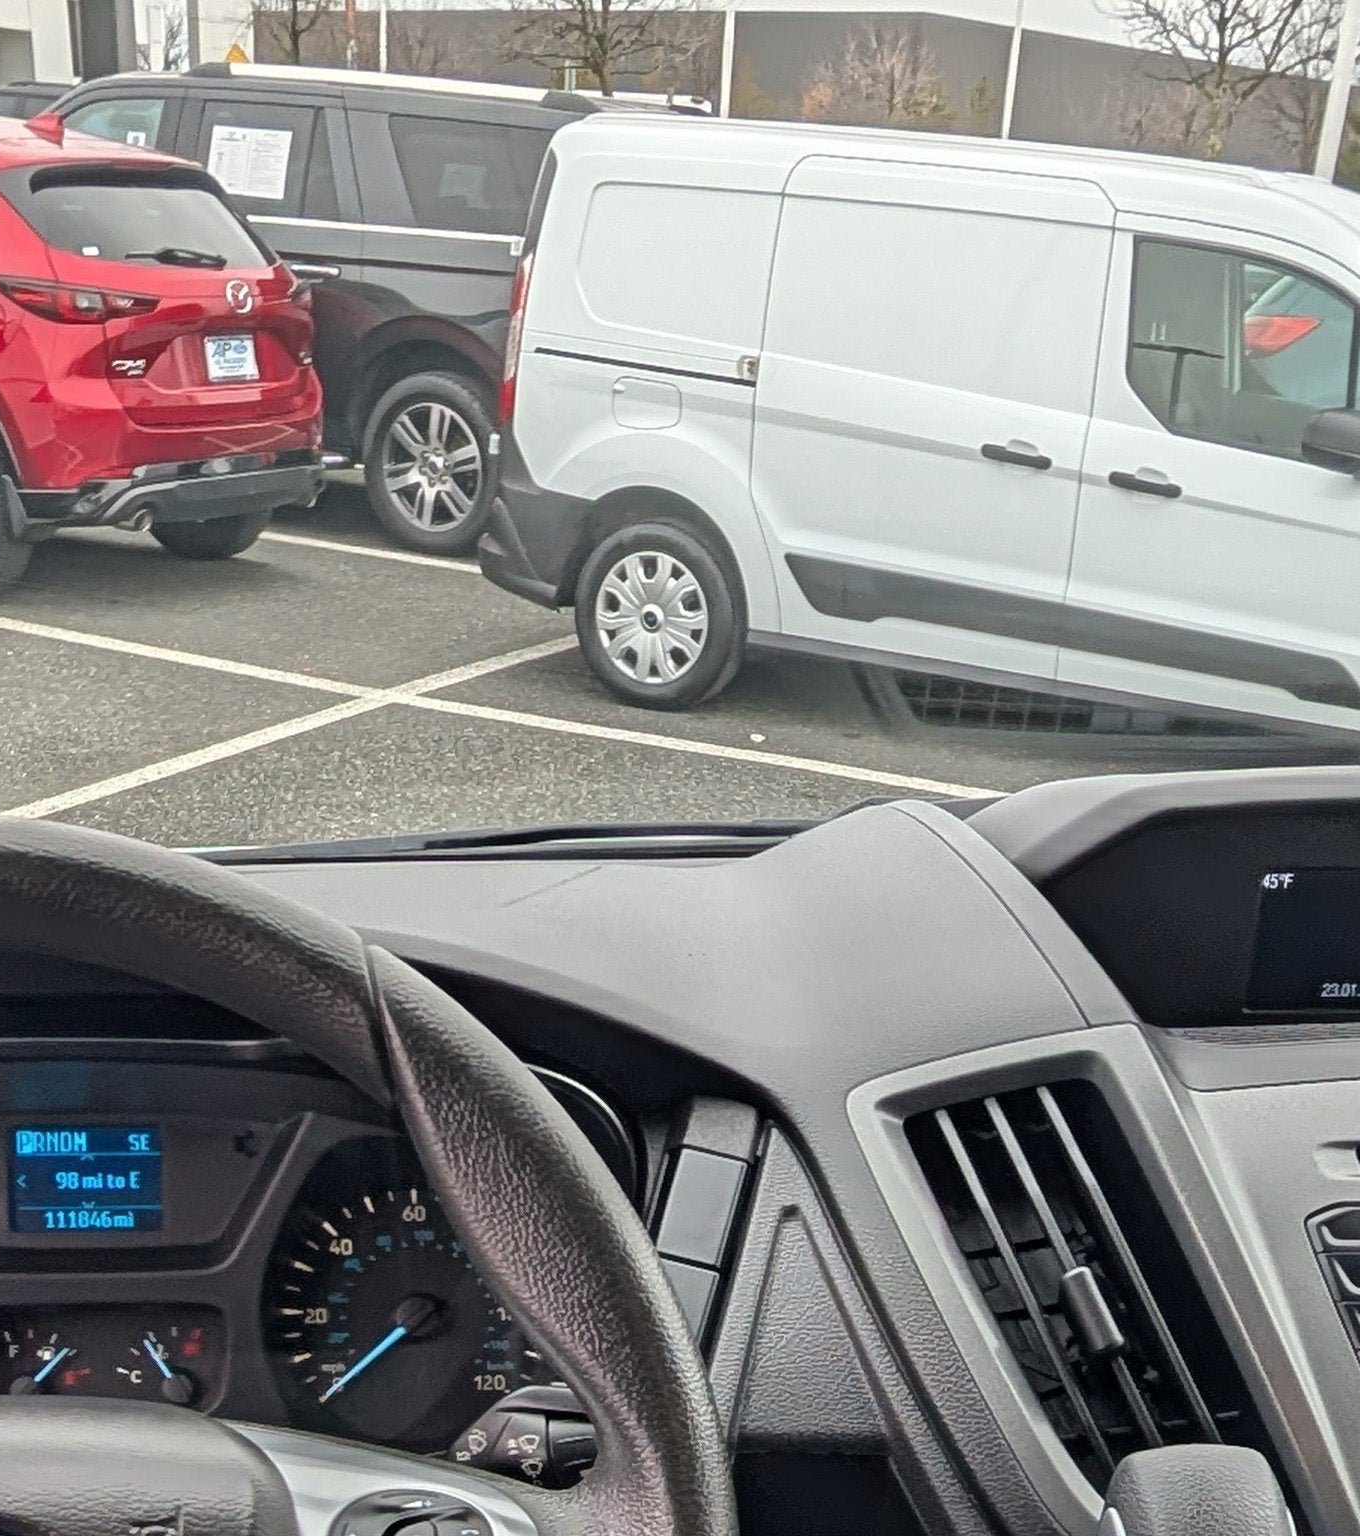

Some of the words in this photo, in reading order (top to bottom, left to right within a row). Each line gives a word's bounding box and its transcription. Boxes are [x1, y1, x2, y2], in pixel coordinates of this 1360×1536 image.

[1261, 872, 1294, 890] 45°F
[127, 1134, 150, 1151] SE
[55, 1172, 79, 1189] 98
[82, 1173, 103, 1189] mi
[106, 1174, 126, 1189] to
[129, 1171, 141, 1189] E
[403, 1206, 426, 1222] 60
[329, 1238, 353, 1256] 40
[304, 1307, 328, 1324] 20
[8, 1345, 20, 1358] F
[129, 1369, 143, 1384] C
[473, 1373, 507, 1391] 120
